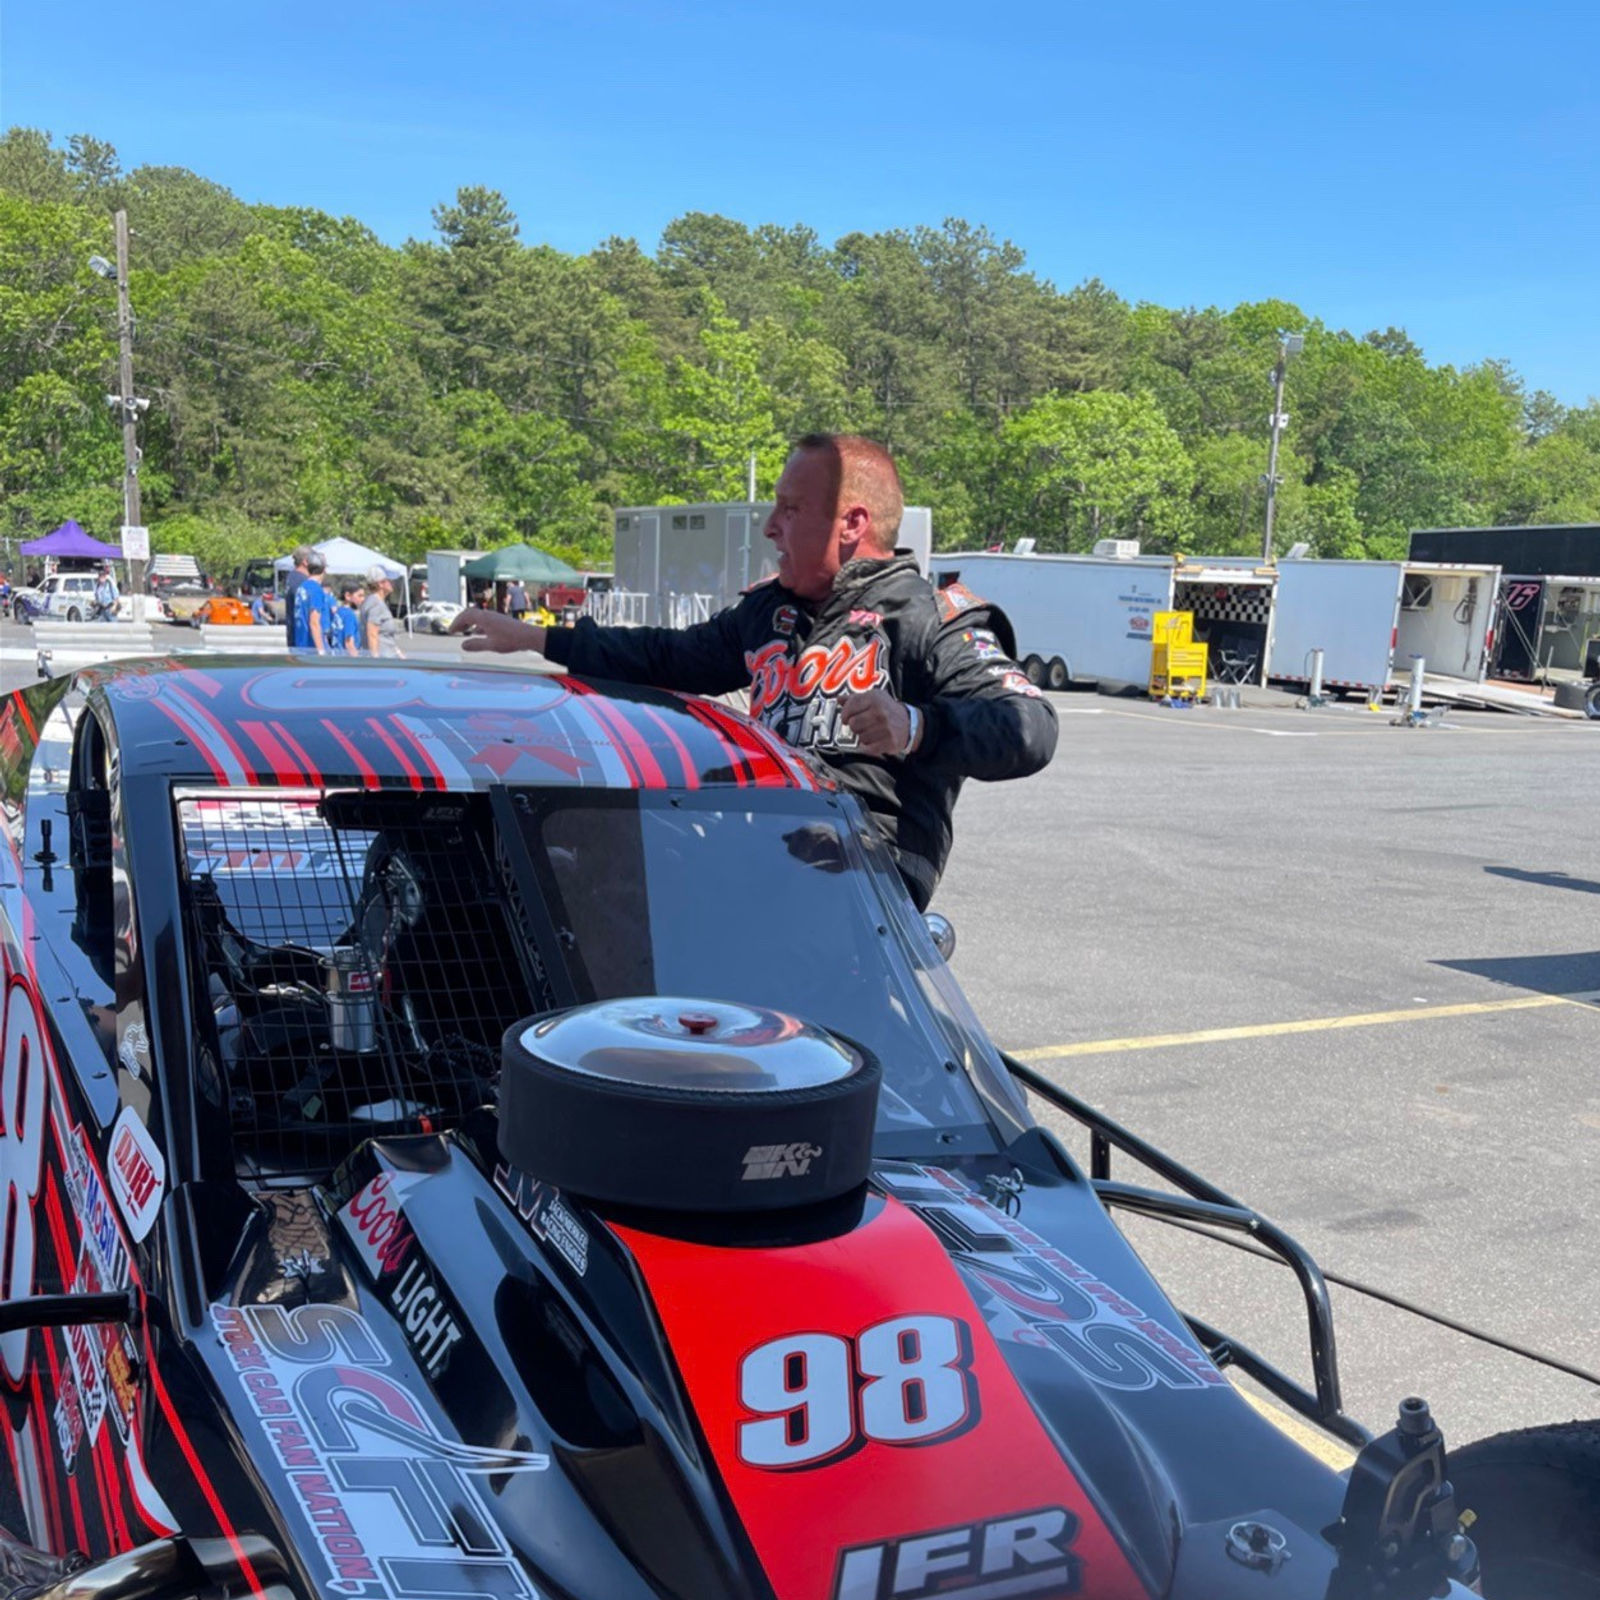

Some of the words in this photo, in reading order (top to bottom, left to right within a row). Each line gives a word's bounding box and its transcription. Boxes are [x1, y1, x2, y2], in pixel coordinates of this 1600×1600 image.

[745, 633, 889, 719] Coors
[114, 1128, 161, 1213] DART
[742, 1143, 823, 1181] K&N
[86, 1164, 118, 1268] Mobil
[349, 1171, 413, 1273] Coors
[390, 1262, 463, 1371] LIGHT
[210, 1303, 271, 1371] STOCK
[244, 1371, 292, 1415] CAR
[268, 1418, 320, 1467] FAN
[736, 1314, 981, 1472] 98
